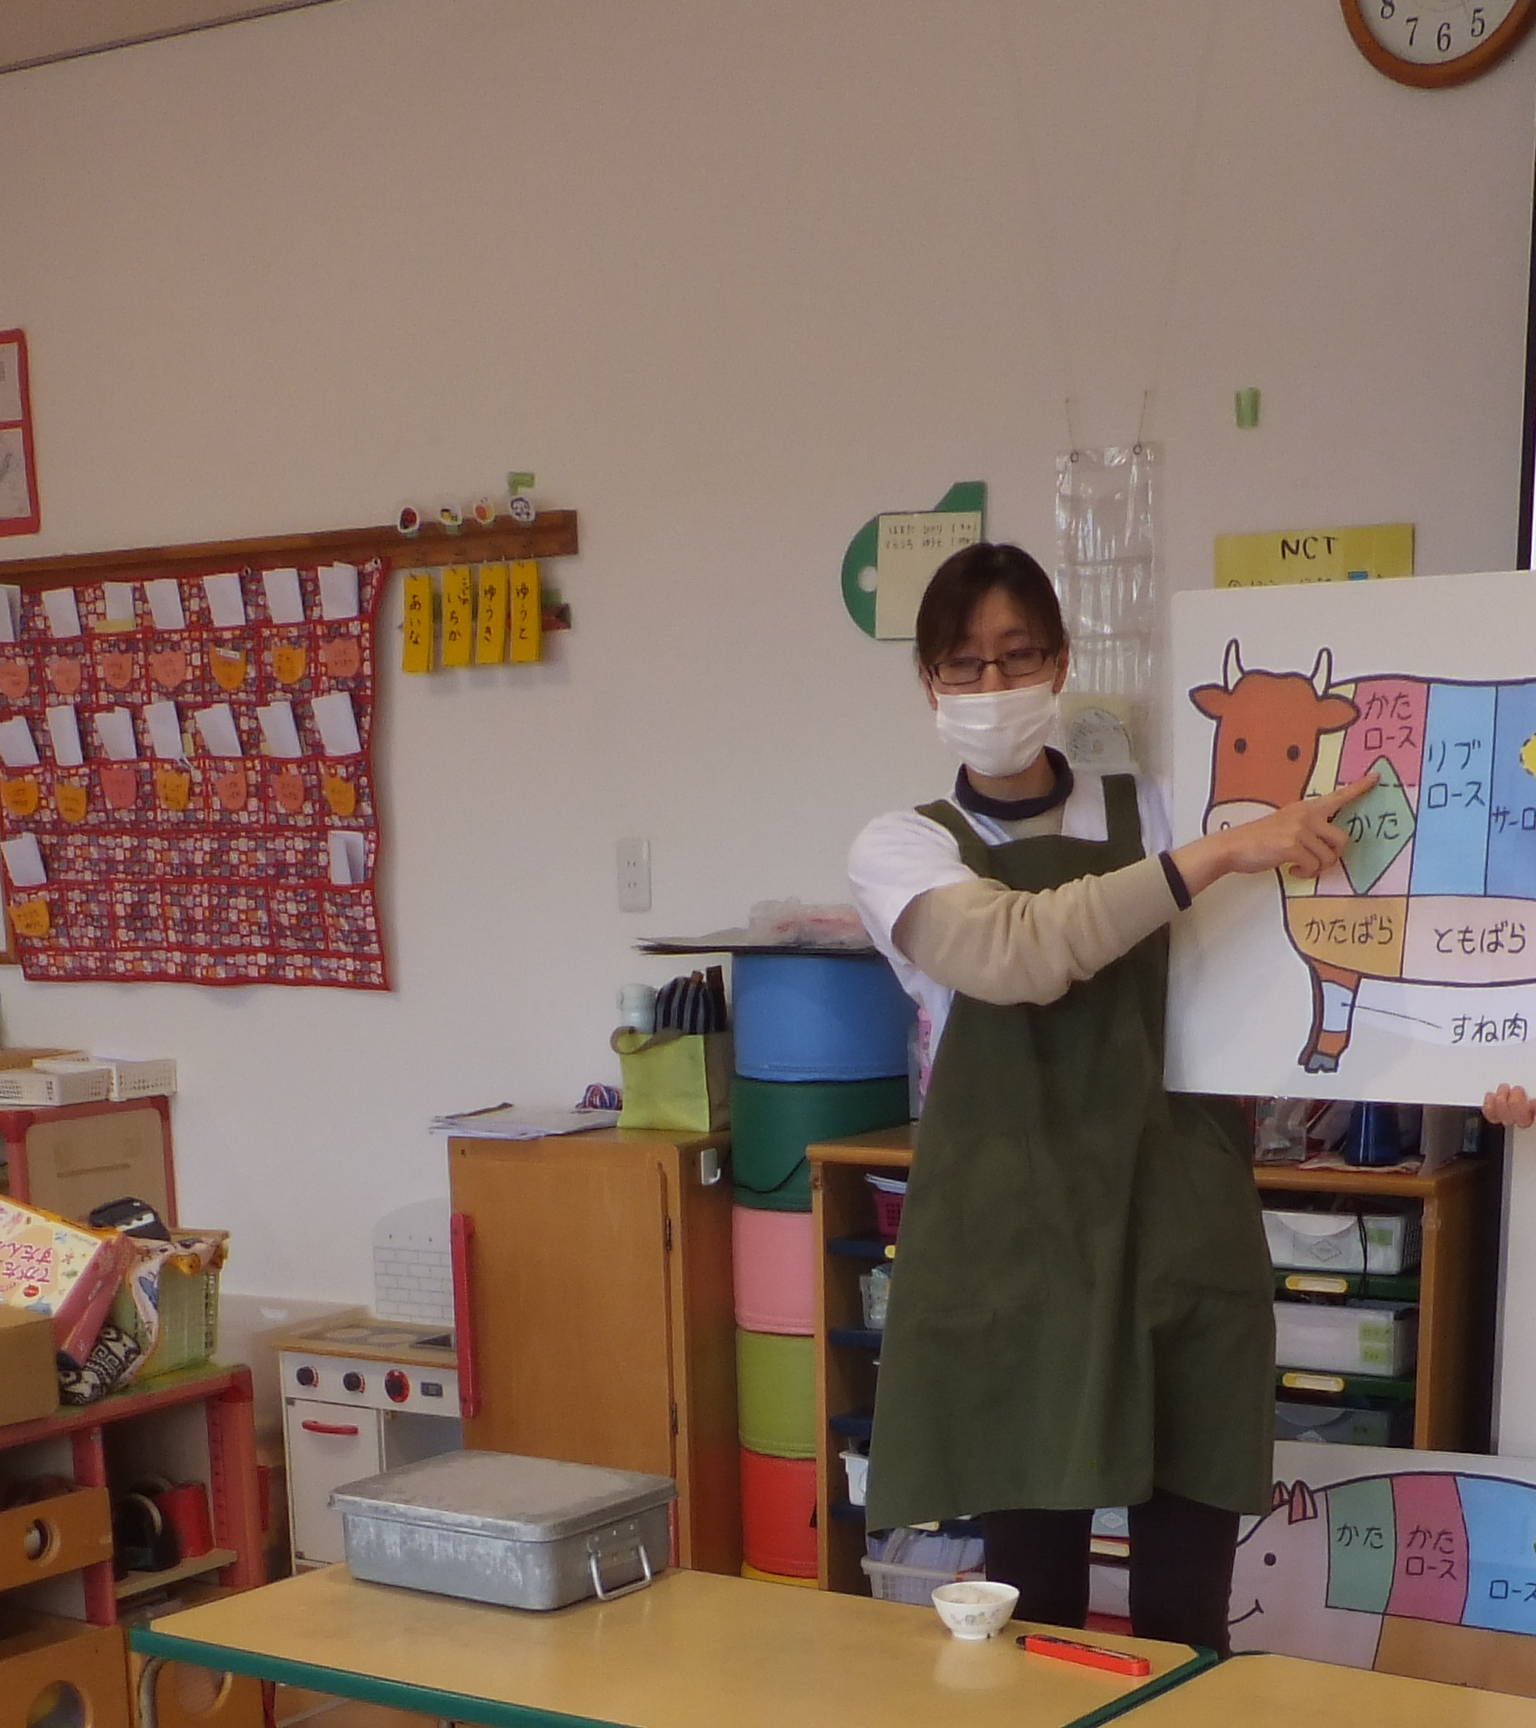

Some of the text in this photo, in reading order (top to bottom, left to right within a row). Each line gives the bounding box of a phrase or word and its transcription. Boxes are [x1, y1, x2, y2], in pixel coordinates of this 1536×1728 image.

[1405, 16, 1419, 47] 7
[1436, 22, 1452, 52] 6
[1470, 7, 1485, 38] 5
[1280, 535, 1338, 561] NCT
[1363, 691, 1413, 721] かた
[1363, 725, 1418, 751] ロース
[1427, 739, 1482, 773] リブ
[1427, 780, 1487, 810] ロース
[1346, 811, 1401, 844] かた
[1304, 913, 1395, 946] かたばら
[1433, 922, 1528, 956] ともばら
[1450, 1013, 1530, 1045] すね肉
[1336, 1523, 1384, 1549] かた
[1407, 1523, 1455, 1554] かた
[1405, 1557, 1457, 1581] ロース
